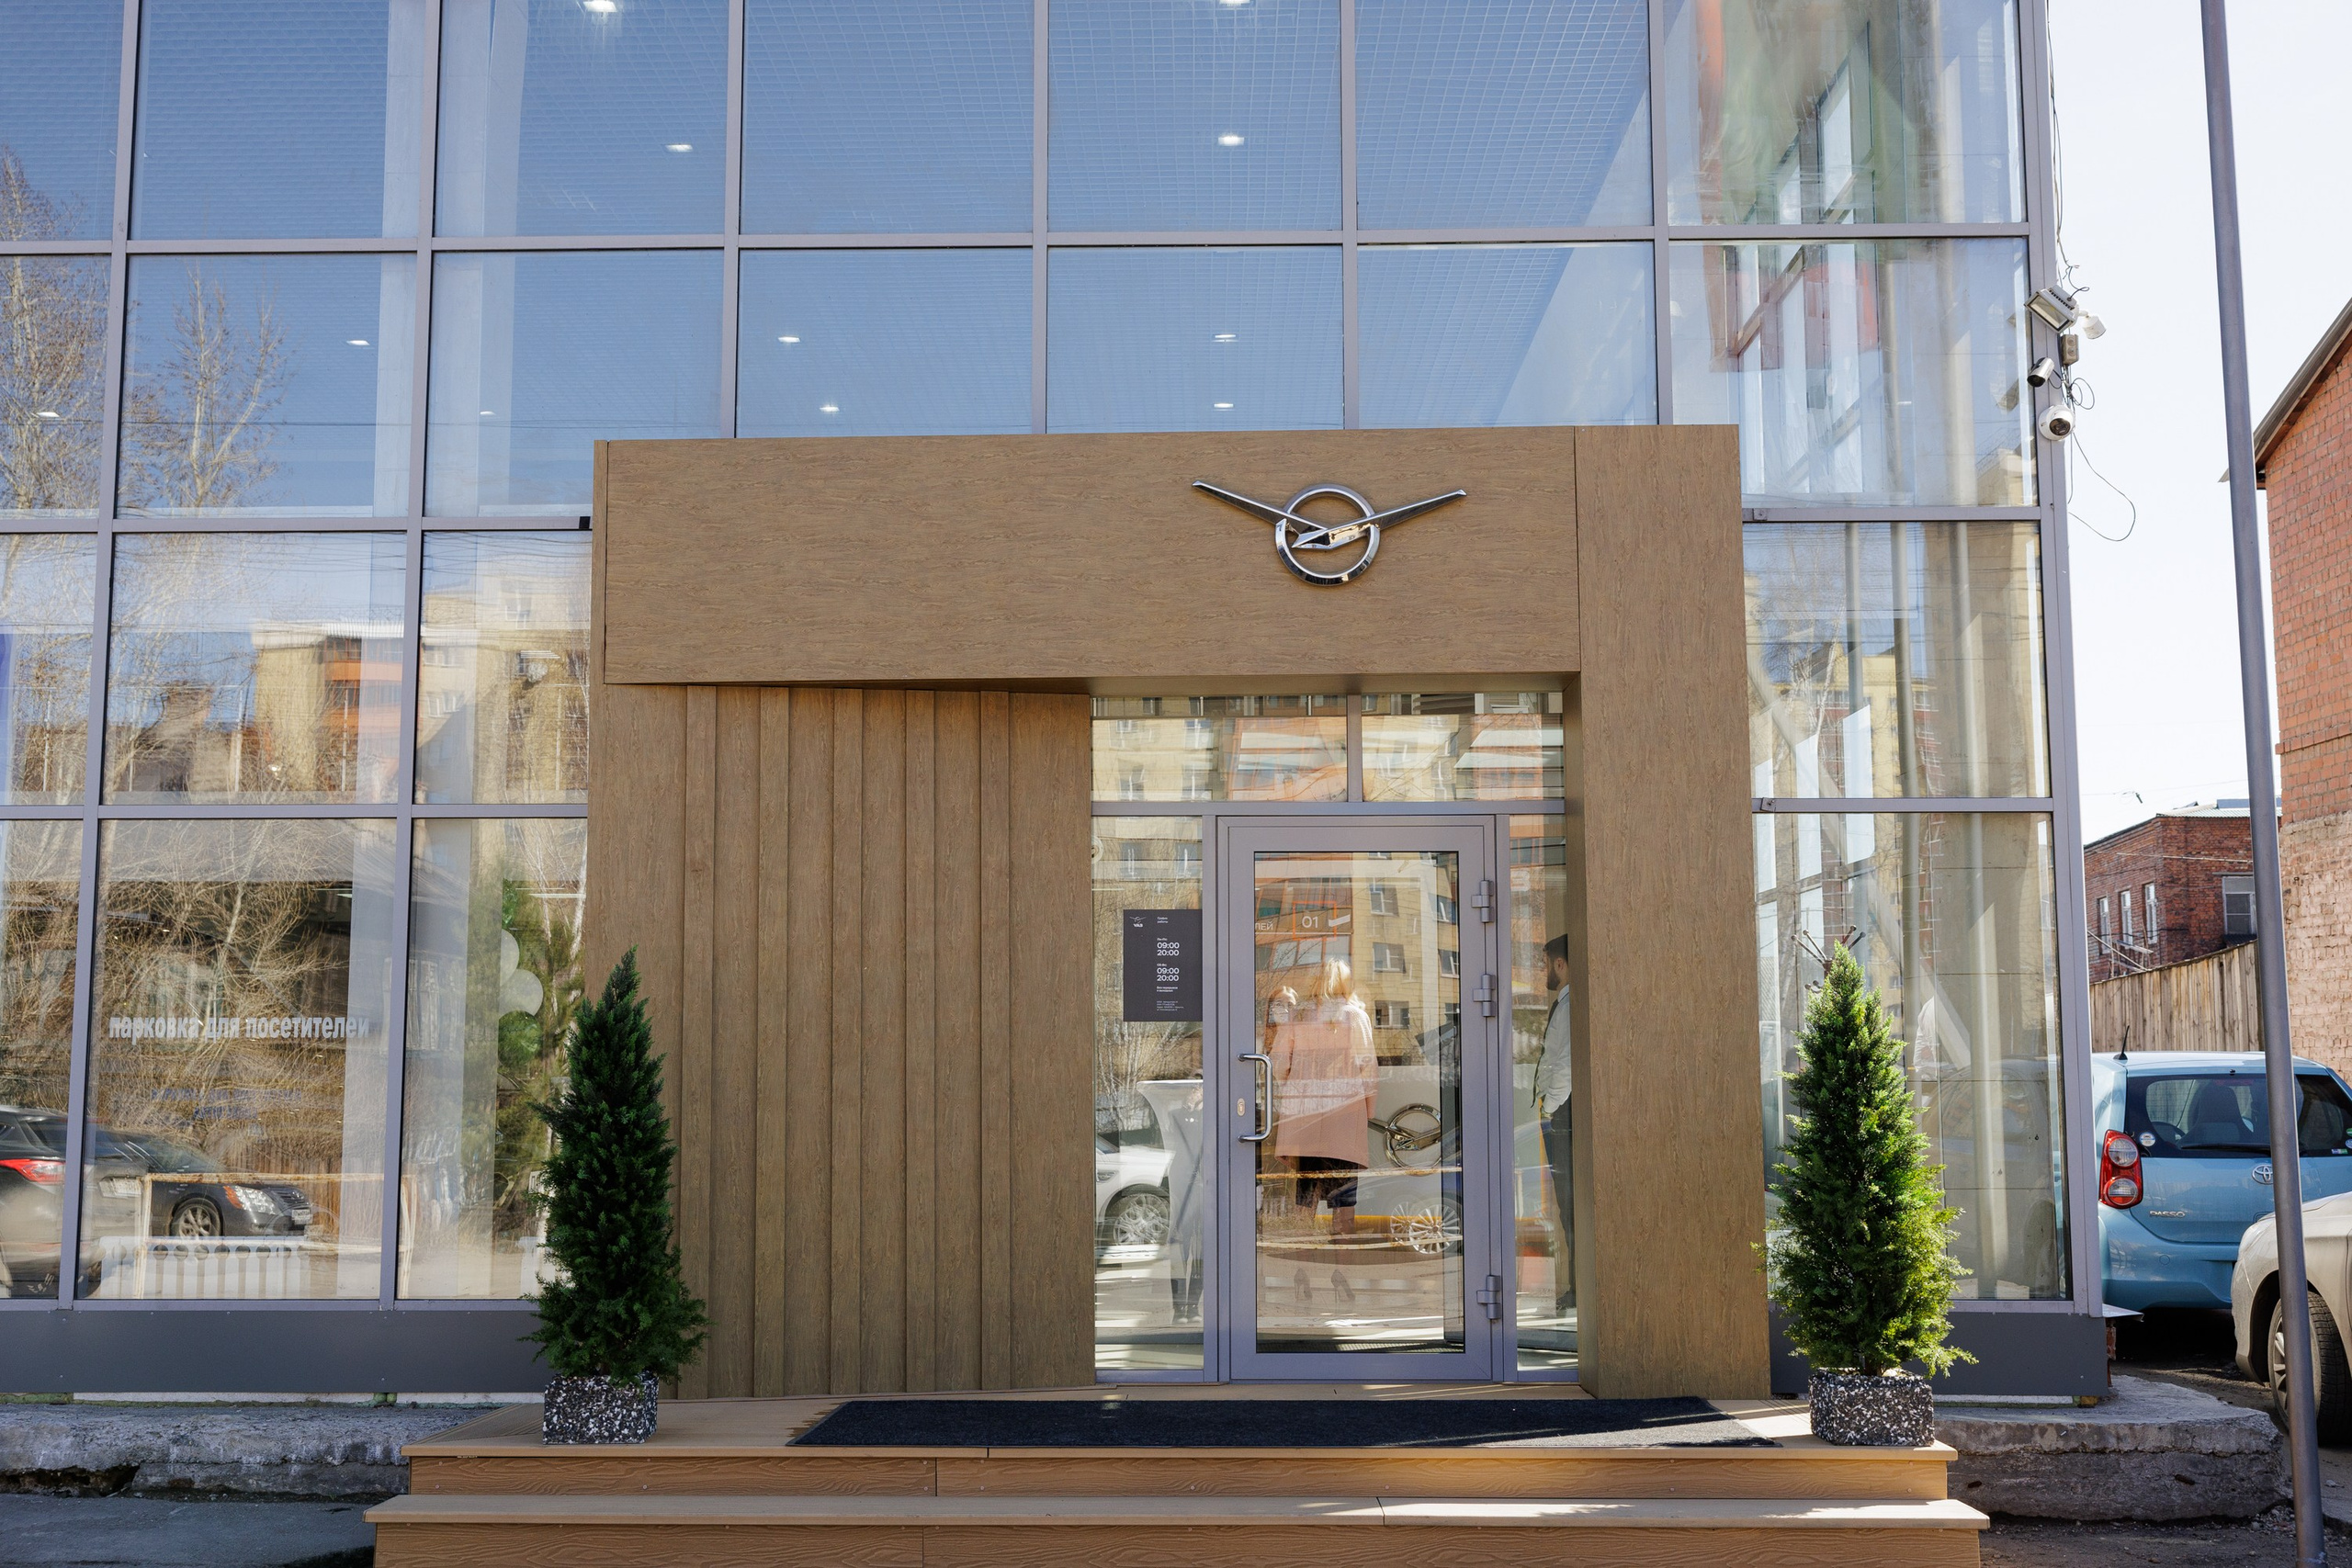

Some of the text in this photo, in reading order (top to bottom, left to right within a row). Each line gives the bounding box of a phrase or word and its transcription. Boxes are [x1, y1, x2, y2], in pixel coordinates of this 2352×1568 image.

[1302, 916, 1318, 929] 01
[108, 1016, 199, 1045] парковка
[204, 1016, 241, 1043] для
